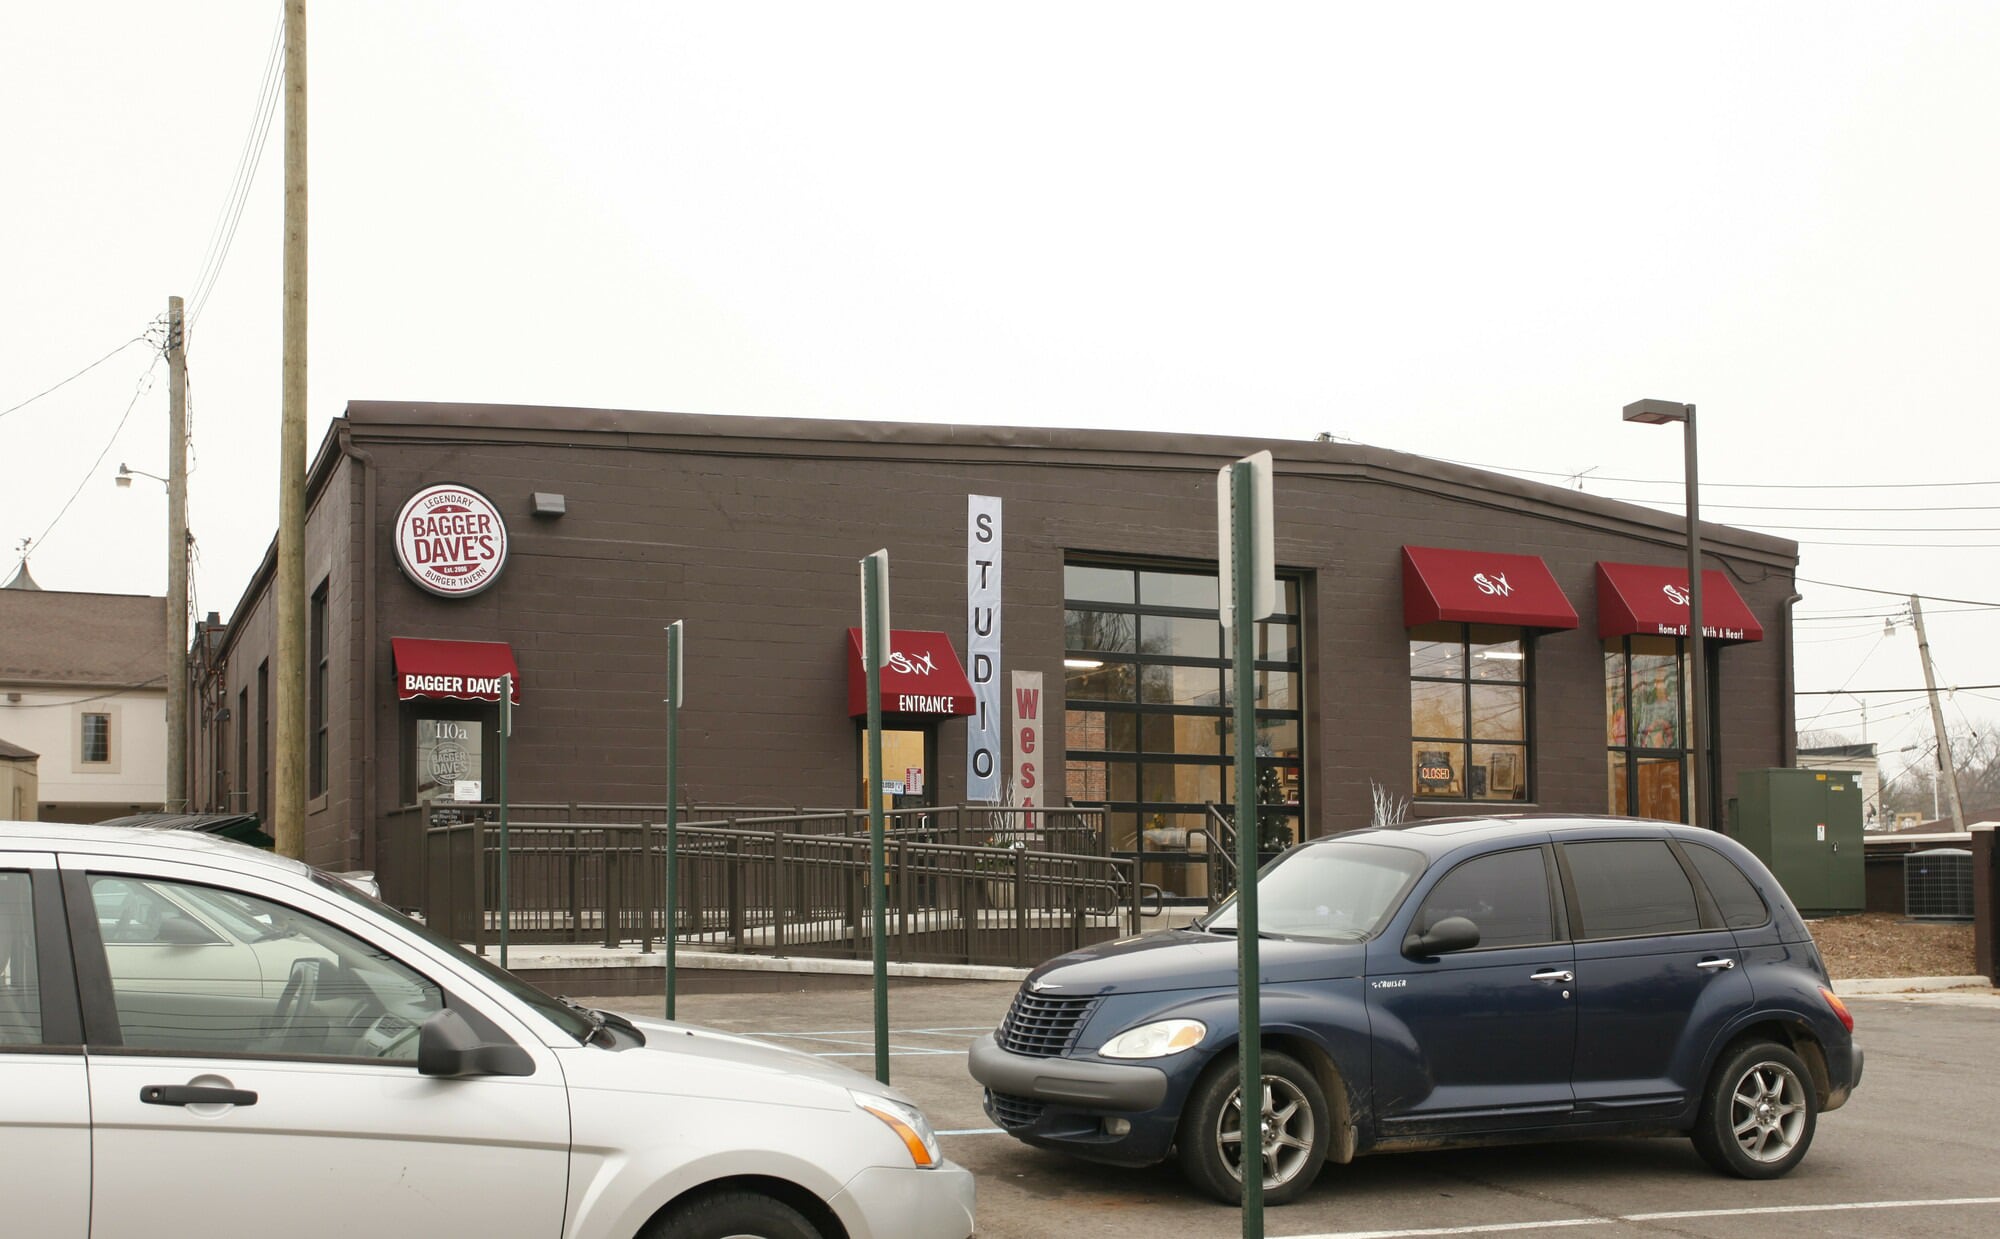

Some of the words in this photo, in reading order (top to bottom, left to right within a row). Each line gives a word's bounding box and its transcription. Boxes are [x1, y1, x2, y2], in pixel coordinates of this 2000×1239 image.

[423, 495, 474, 509] LEGENDARY
[412, 514, 492, 538] BAGGER
[414, 535, 495, 564] DAVE'S
[424, 569, 457, 587] BURGER
[459, 567, 487, 586] TAVERN
[1658, 623, 1677, 635] Home
[1679, 624, 1687, 636] Of
[1702, 625, 1717, 638] With
[1719, 627, 1724, 638] A
[1725, 628, 1744, 639] Heart
[972, 513, 995, 779] STUDIO
[405, 674, 463, 692] BAGGER
[467, 677, 514, 695] DAVE
[899, 694, 954, 713] ENTRANCE
[435, 722, 468, 740] 110a
[431, 751, 466, 763] BAGGER
[1016, 688, 1039, 829] West
[1422, 767, 1450, 779] CLOSED
